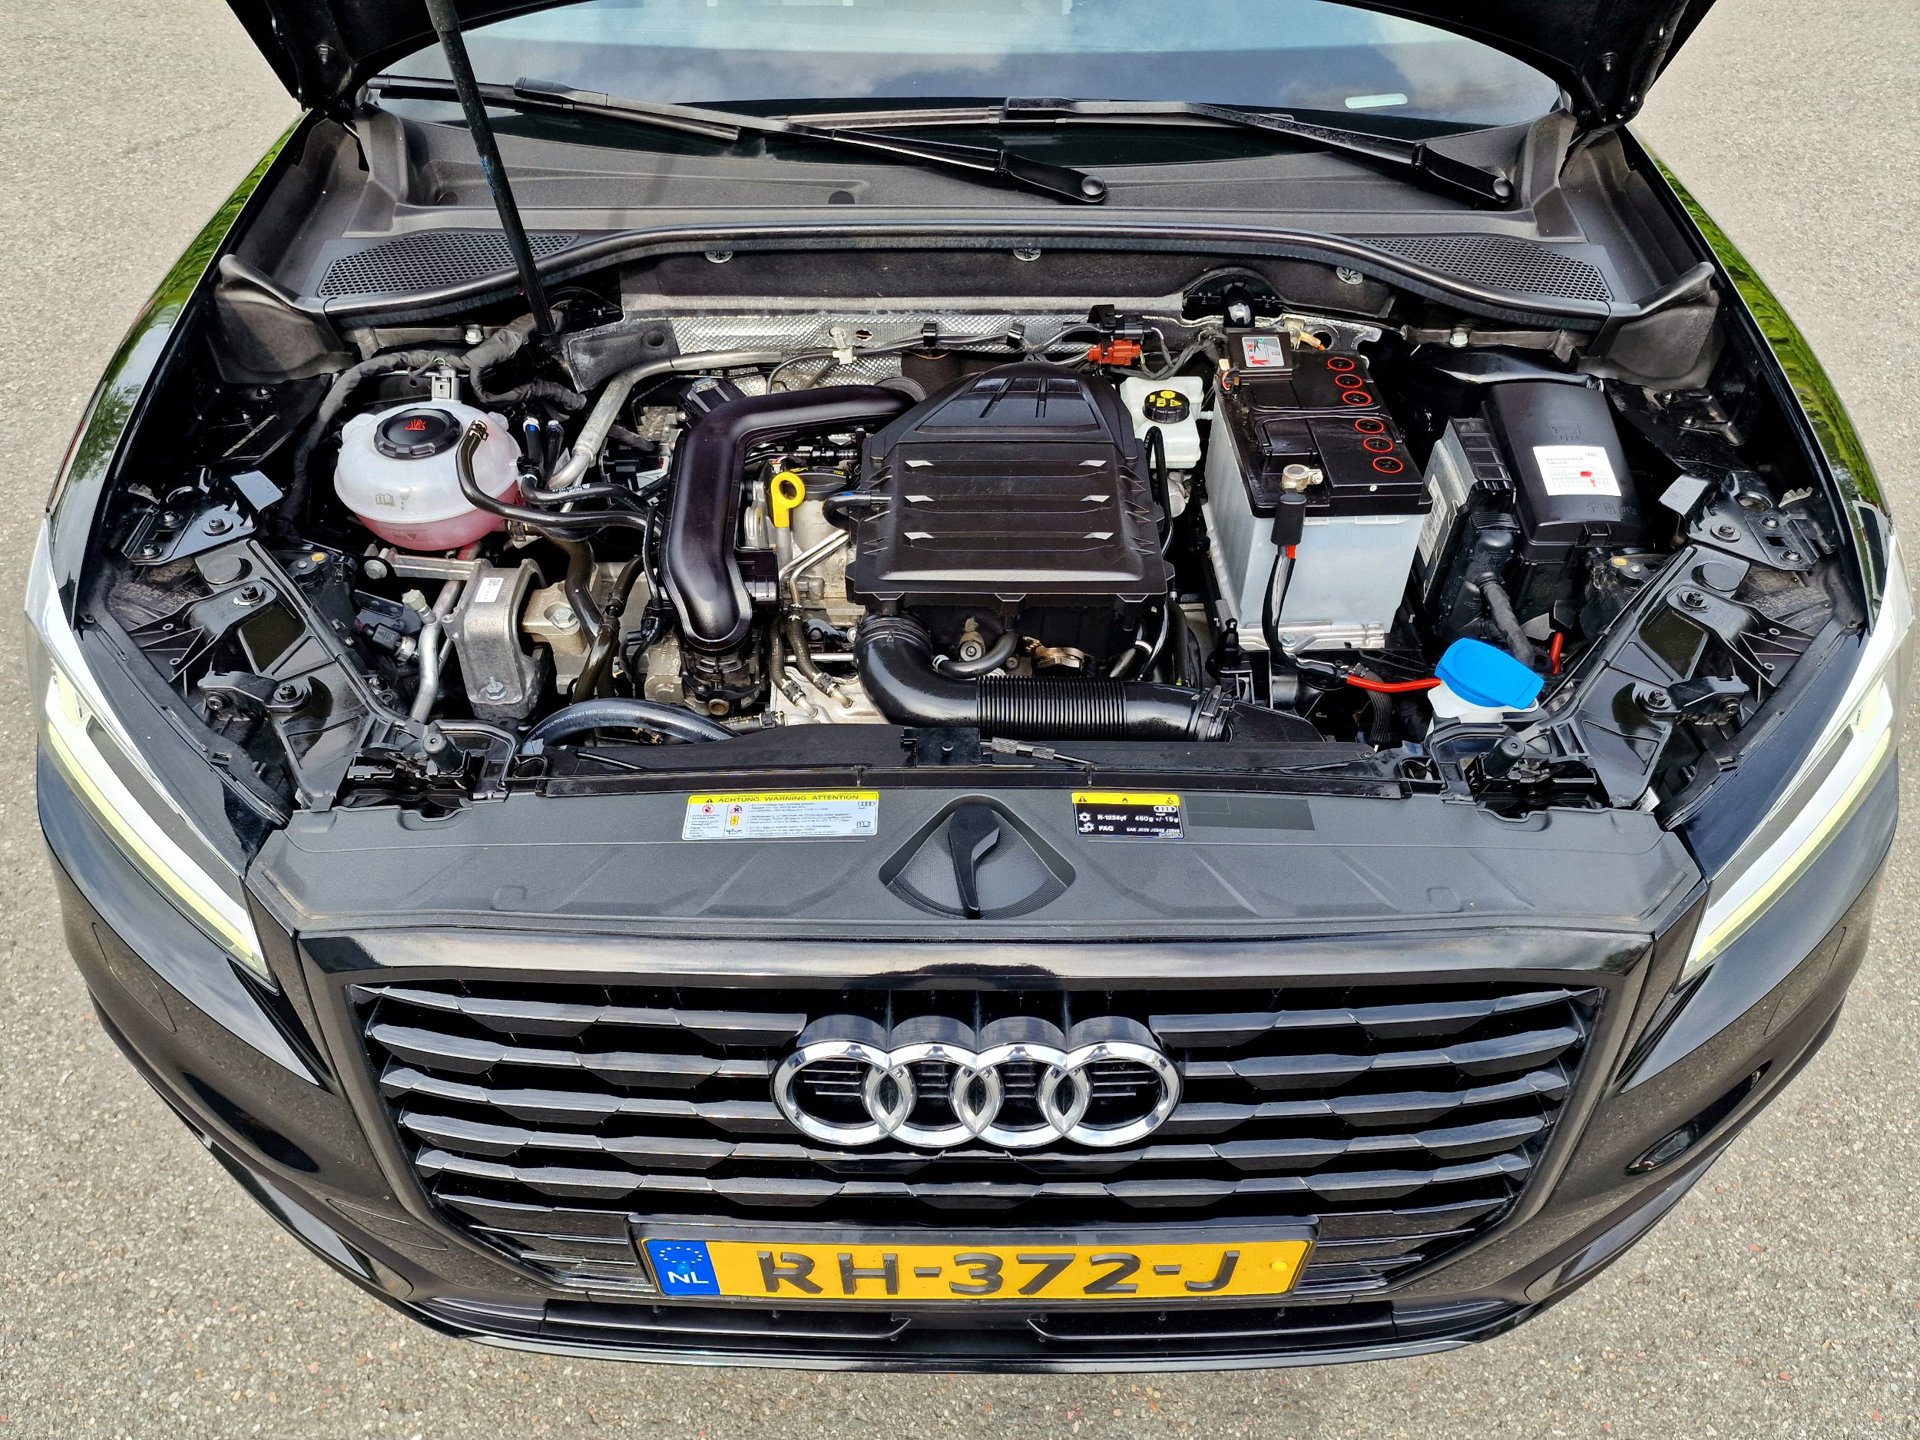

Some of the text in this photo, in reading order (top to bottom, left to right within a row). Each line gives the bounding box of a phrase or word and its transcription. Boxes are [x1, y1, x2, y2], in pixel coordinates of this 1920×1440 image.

[1097, 814, 1127, 822] R-1234yf
[667, 1271, 710, 1284] NL
[757, 1250, 1241, 1296] RH-372-J
